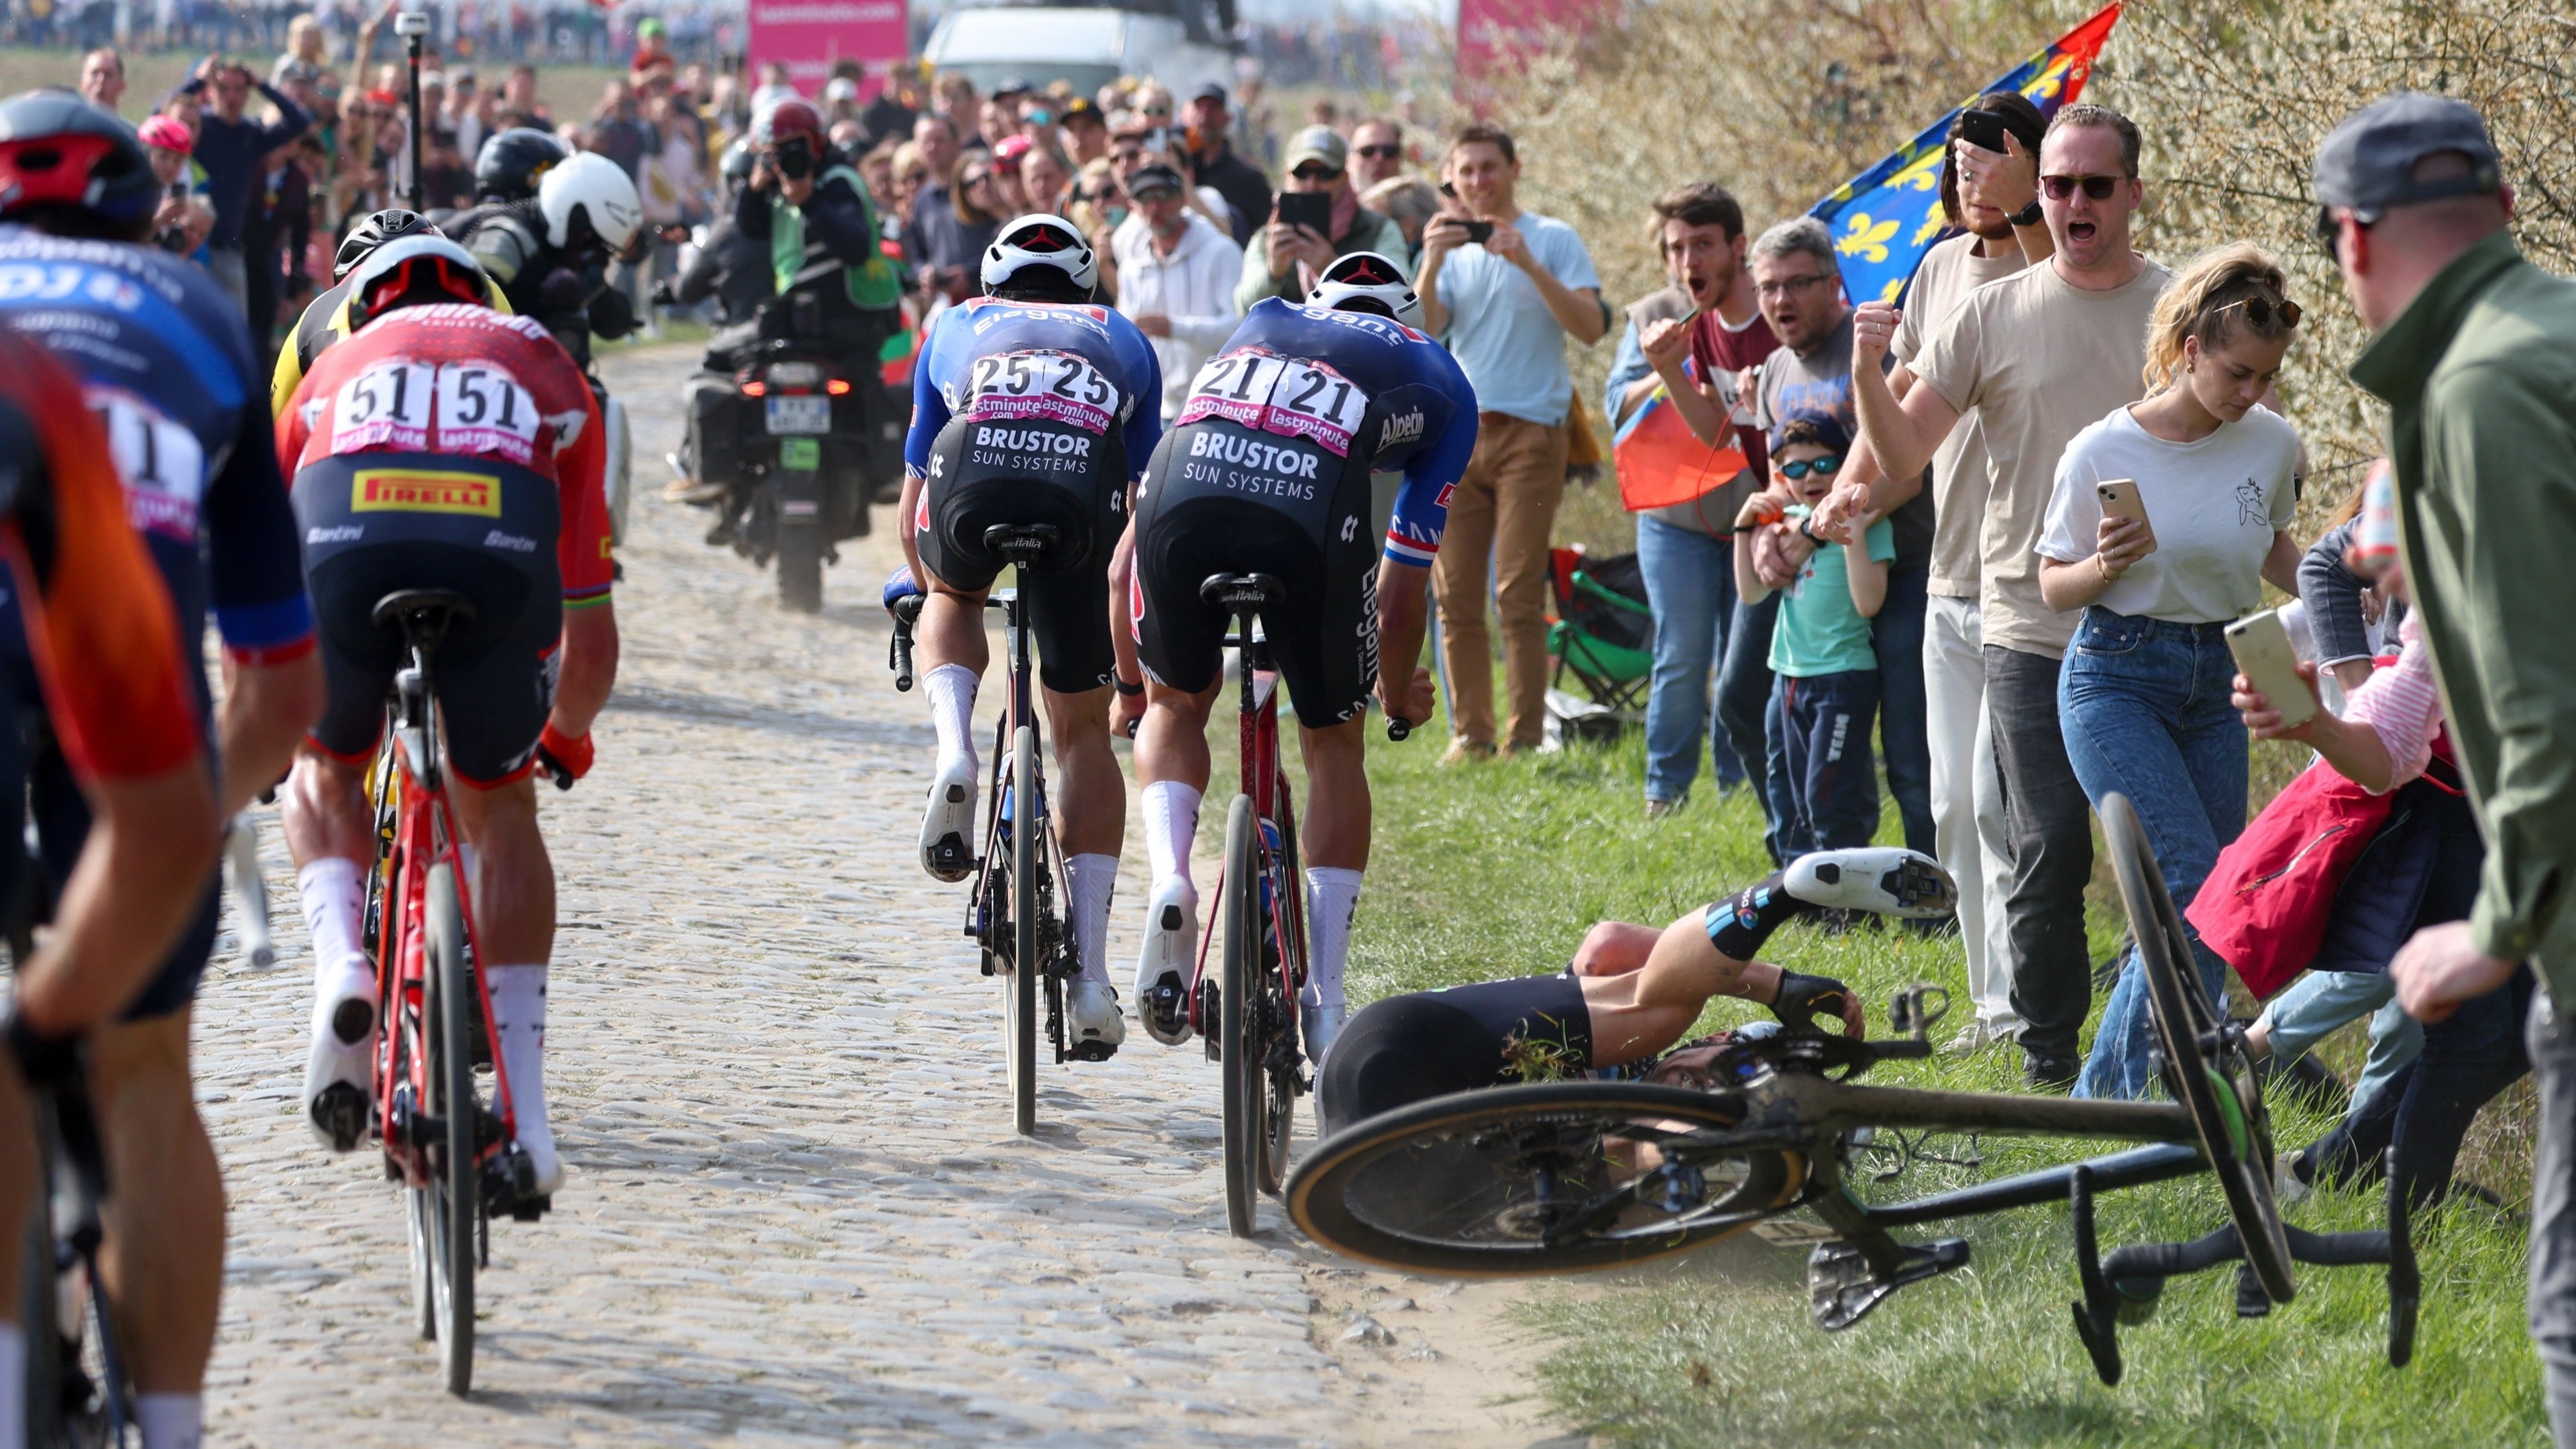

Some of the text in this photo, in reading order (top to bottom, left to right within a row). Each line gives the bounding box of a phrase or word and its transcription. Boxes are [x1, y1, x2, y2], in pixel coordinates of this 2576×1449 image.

[351, 366, 410, 423] 51
[977, 356, 1031, 394] 25
[1053, 359, 1109, 405] 25
[1198, 358, 1261, 401] 21
[458, 370, 517, 430] 51
[990, 411, 1014, 419] .com
[1289, 370, 1352, 426] 21
[1061, 415, 1084, 427] .com
[1271, 408, 1349, 450] lastminute
[973, 450, 1087, 474] SUN SYSTEMS
[976, 427, 1091, 458] BRUSTOR
[1190, 431, 1319, 480] BRUSTOR
[365, 477, 489, 507] PIRELLI
[1184, 463, 1315, 501] SUN SYSTEMS
[1827, 714, 1850, 762] TEAM
